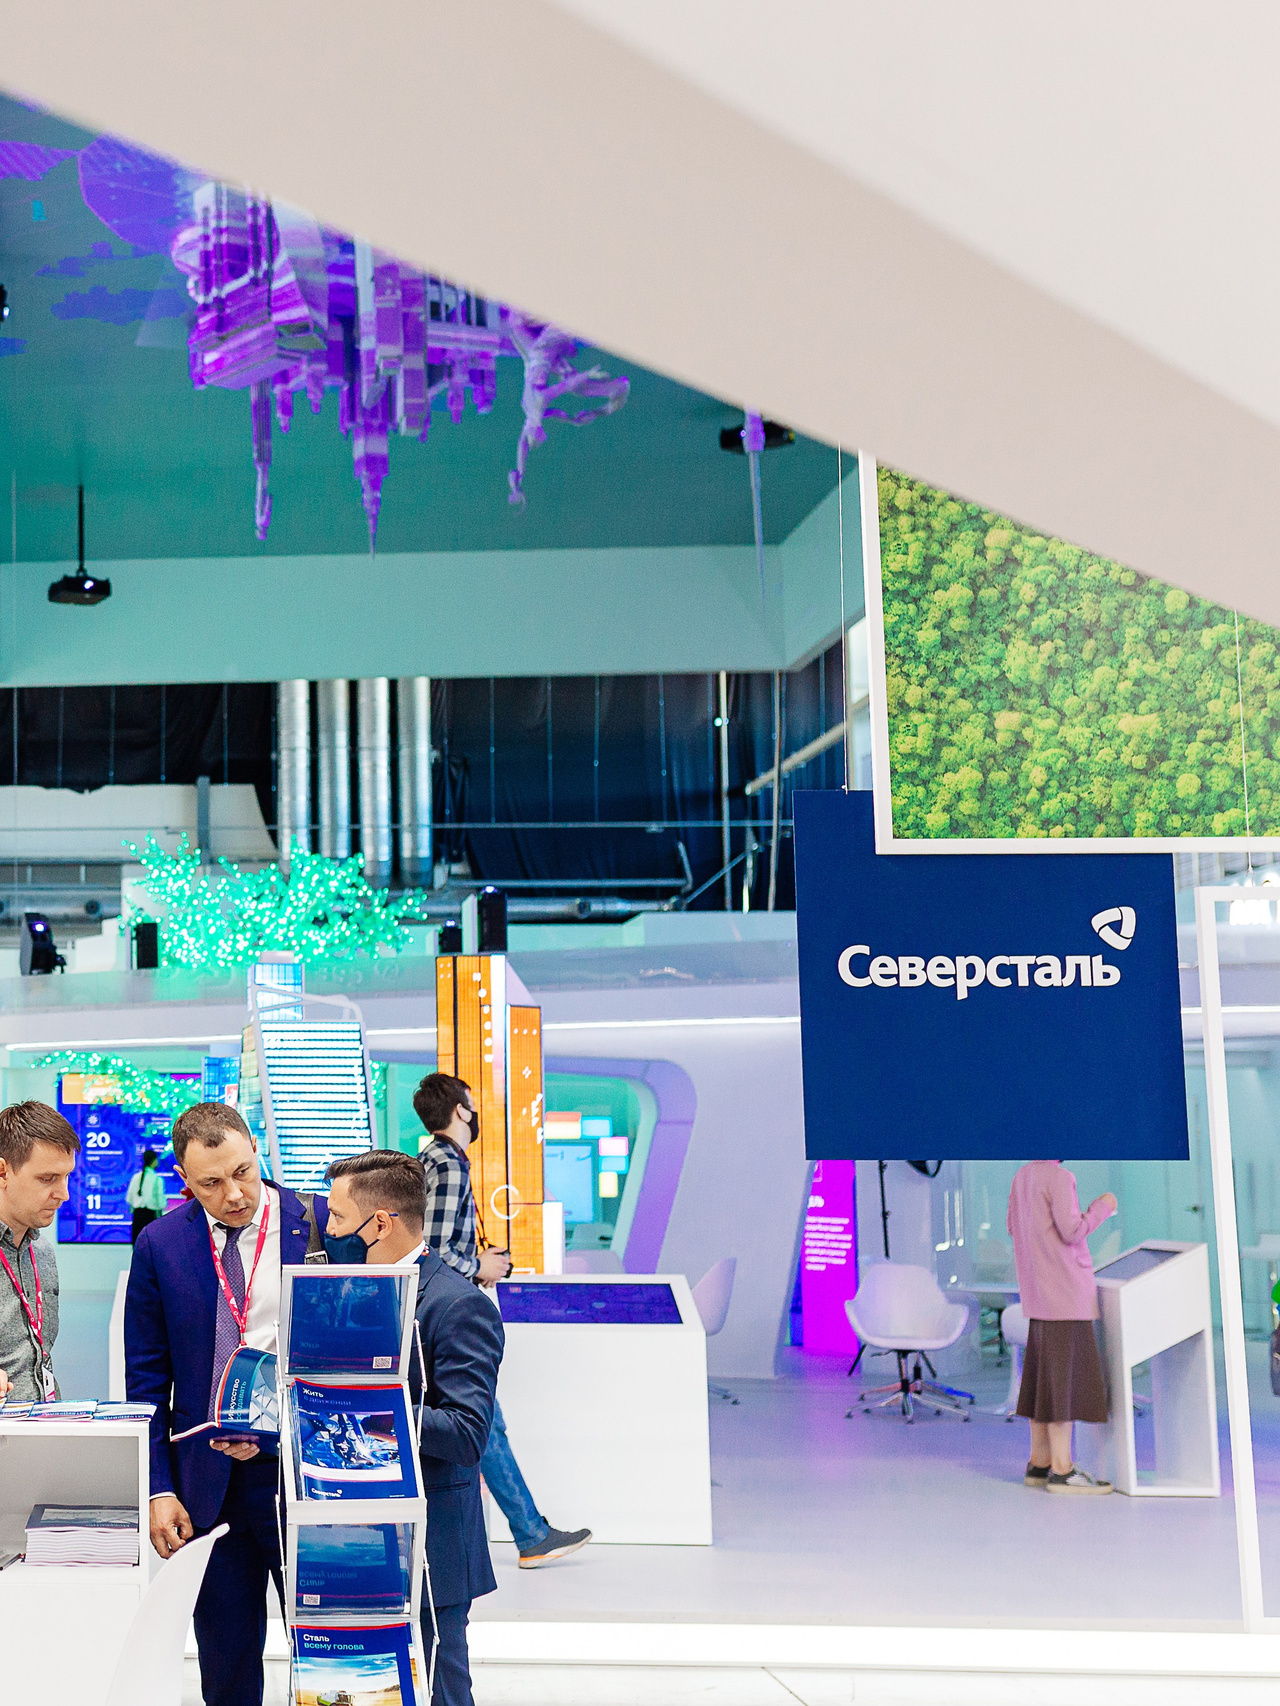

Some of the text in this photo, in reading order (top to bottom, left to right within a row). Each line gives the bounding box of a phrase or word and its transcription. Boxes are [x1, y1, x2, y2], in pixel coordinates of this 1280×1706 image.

[838, 944, 1121, 1001] Северсталь
[86, 1132, 111, 1148] 20
[86, 1194, 101, 1210] 11
[302, 1387, 324, 1398] Жить
[303, 1633, 330, 1642] Сталь
[304, 1642, 365, 1651] всему голова
